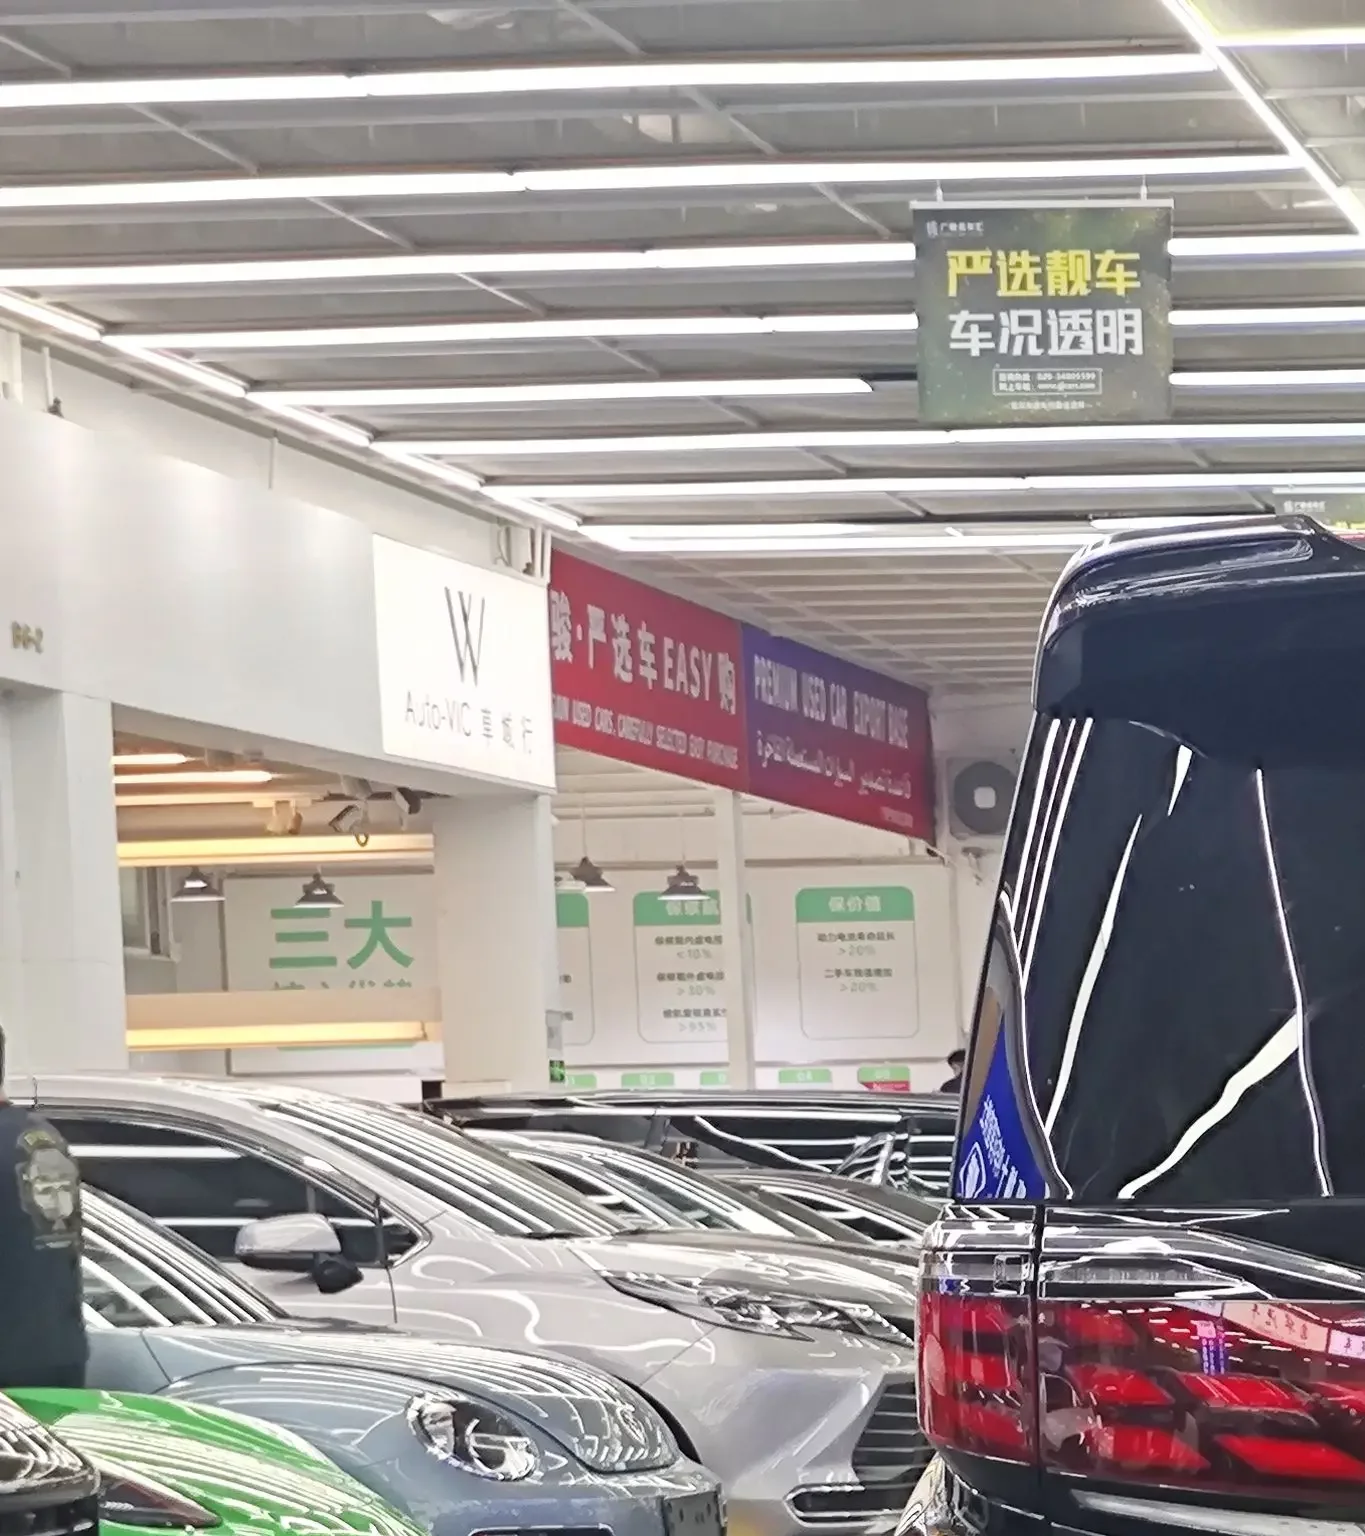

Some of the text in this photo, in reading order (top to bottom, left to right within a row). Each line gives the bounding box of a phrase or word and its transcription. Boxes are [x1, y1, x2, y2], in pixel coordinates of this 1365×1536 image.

[947, 248, 1141, 297] 严选靓车
[949, 308, 1143, 356] 车况透明
[405, 690, 473, 738] Auto-VIC
[270, 900, 414, 969] 三大
